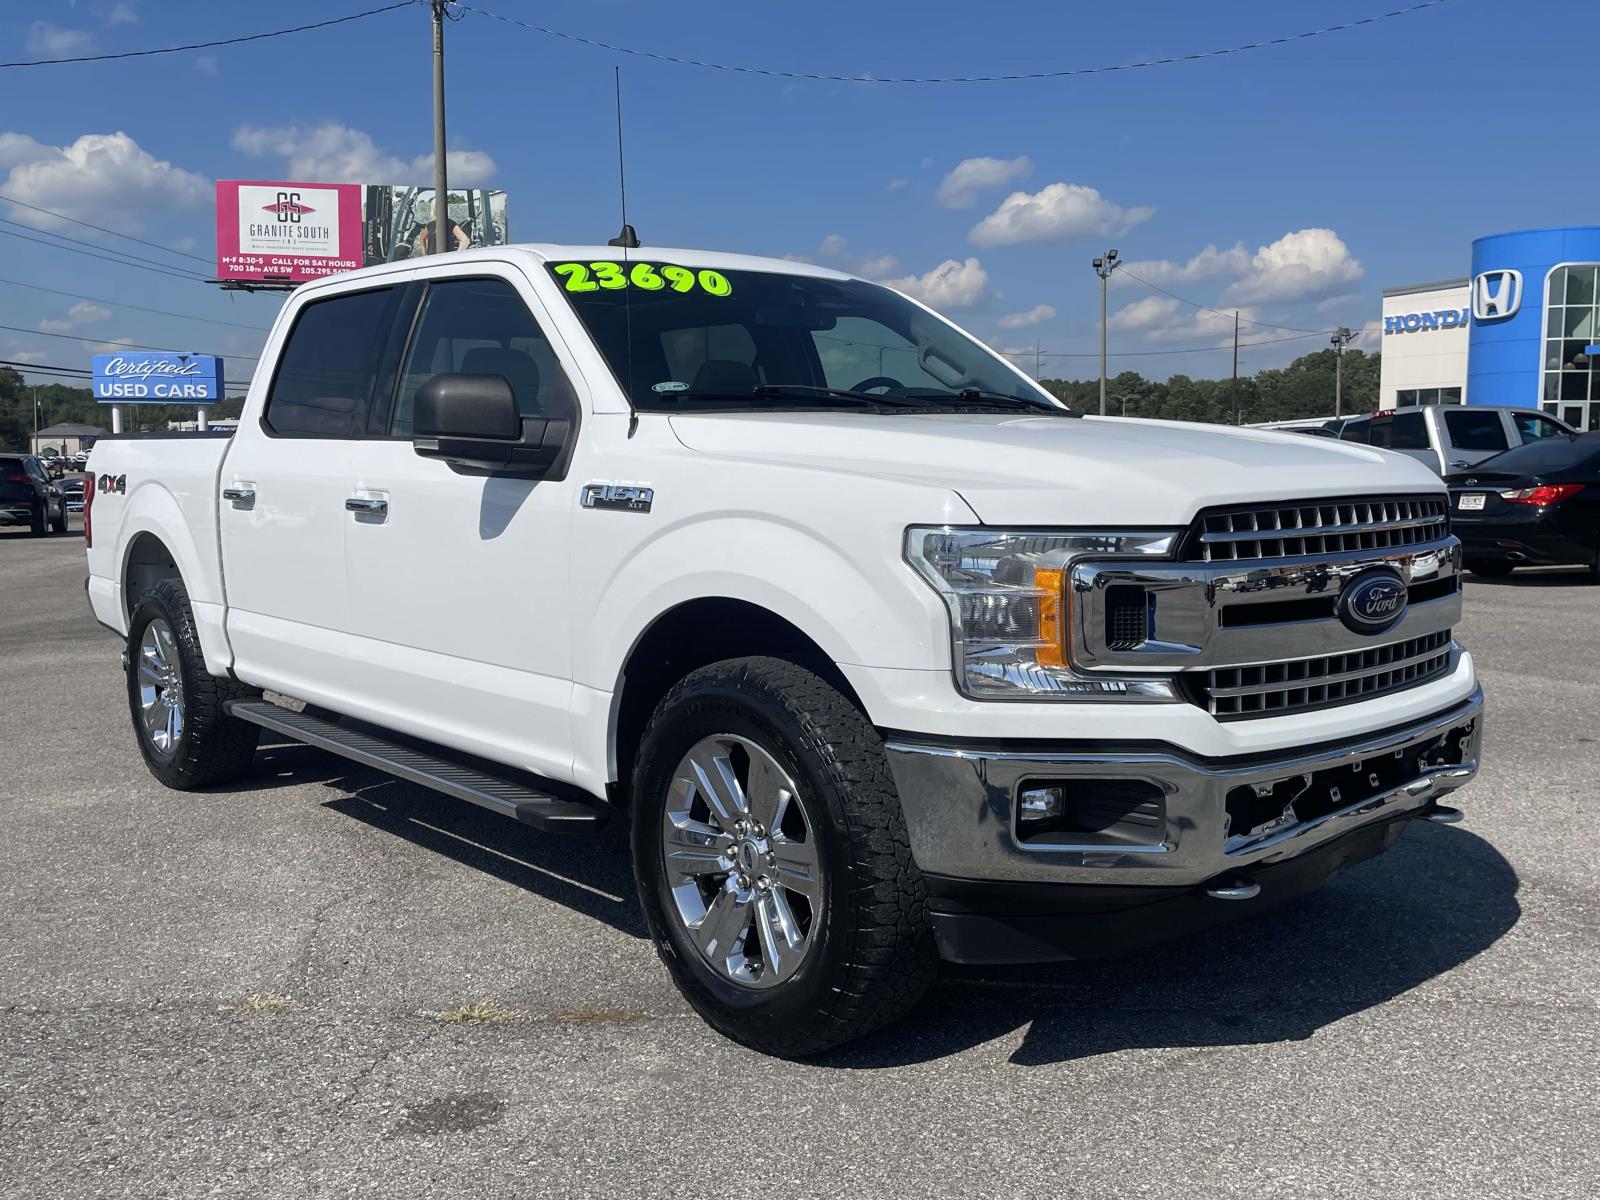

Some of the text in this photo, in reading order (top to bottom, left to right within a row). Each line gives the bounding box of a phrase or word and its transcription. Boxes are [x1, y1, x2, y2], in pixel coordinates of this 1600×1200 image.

[249, 223, 329, 239] GRANITE SOUTH
[554, 262, 732, 297] 23690
[105, 357, 201, 381] Certified
[100, 384, 208, 398] USED CARS
[1366, 587, 1398, 614] Ford
